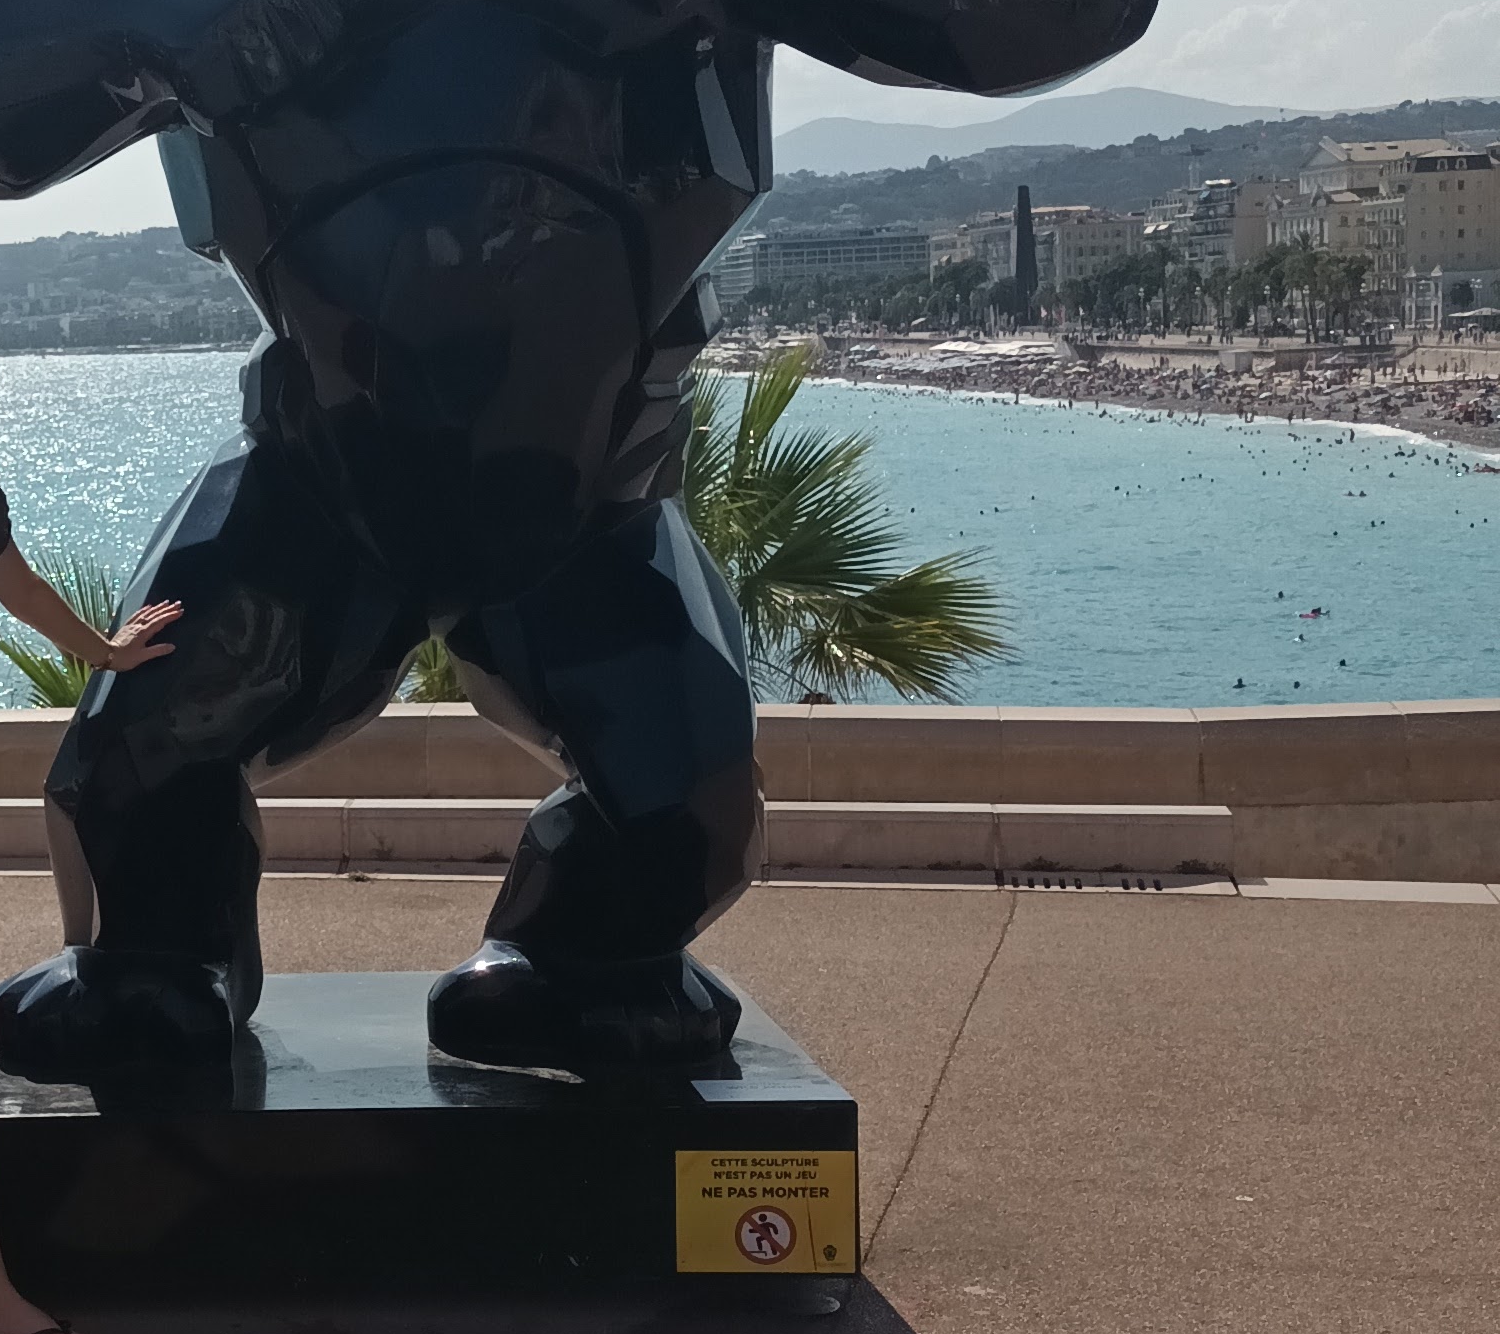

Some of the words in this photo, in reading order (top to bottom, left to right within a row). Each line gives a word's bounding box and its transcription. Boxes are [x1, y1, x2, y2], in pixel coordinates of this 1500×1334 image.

[711, 1158, 748, 1167] CETTE
[750, 1158, 820, 1167] SCULPTURE
[713, 1170, 746, 1180] N'EST
[750, 1170, 773, 1180] PAS
[775, 1170, 792, 1180] UN
[794, 1170, 817, 1180] JEU
[701, 1186, 723, 1198] NE
[727, 1186, 758, 1198] PAS
[762, 1186, 830, 1198] MONTER
